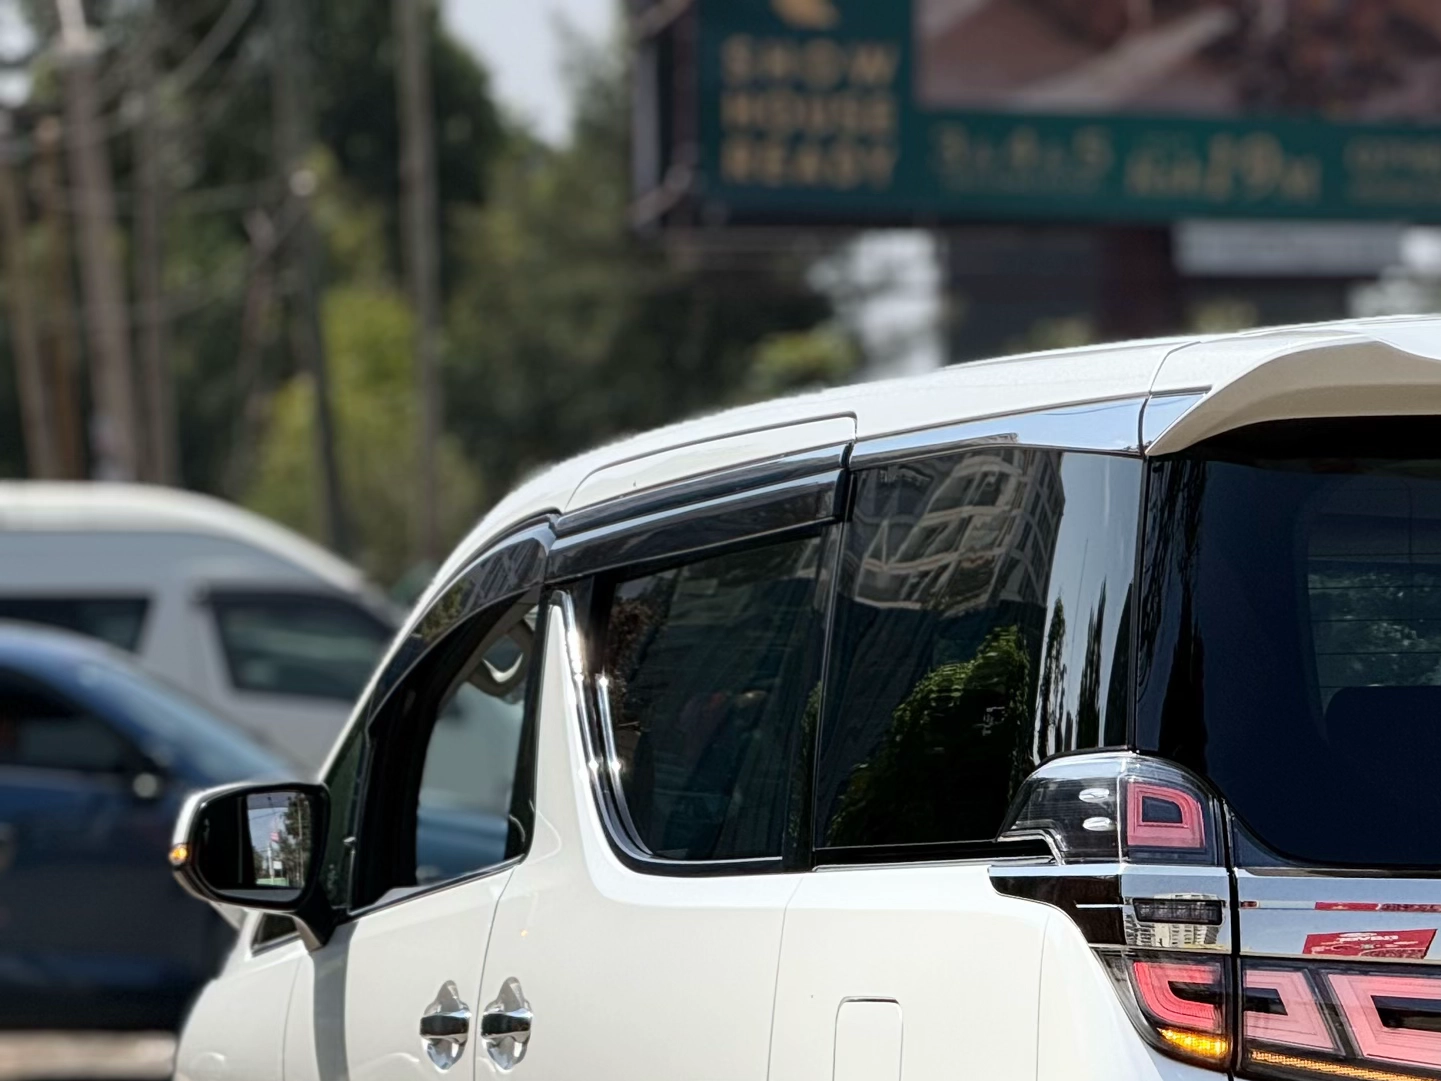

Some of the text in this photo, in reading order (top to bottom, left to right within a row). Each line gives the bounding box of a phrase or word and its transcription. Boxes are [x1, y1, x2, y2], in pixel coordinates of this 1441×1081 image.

[723, 37, 896, 87] SHOW
[724, 88, 896, 138] HOUSE
[723, 137, 896, 187] READY
